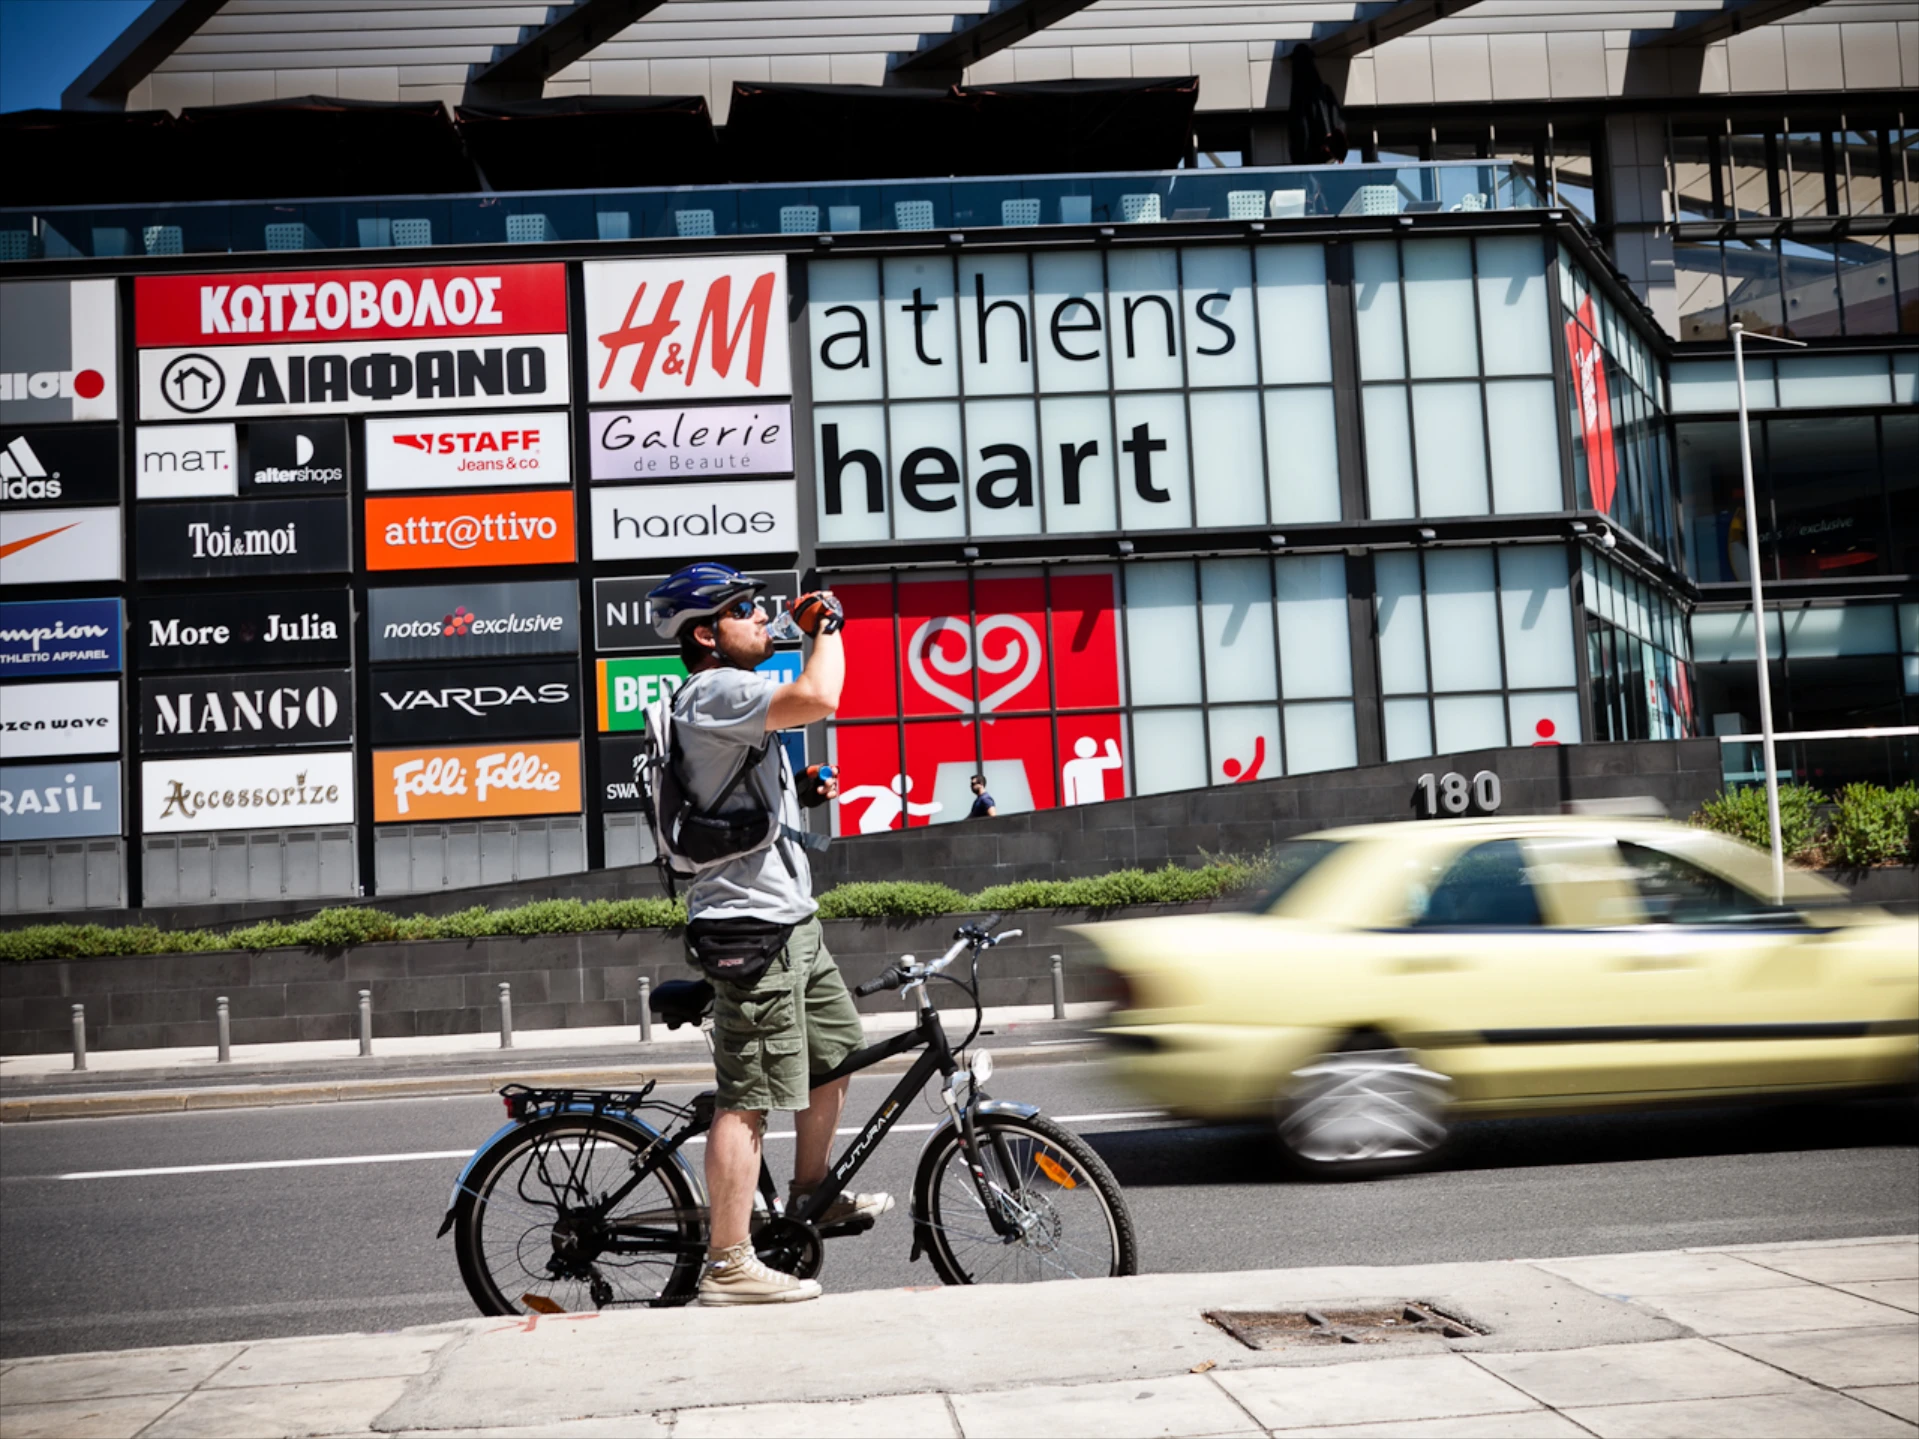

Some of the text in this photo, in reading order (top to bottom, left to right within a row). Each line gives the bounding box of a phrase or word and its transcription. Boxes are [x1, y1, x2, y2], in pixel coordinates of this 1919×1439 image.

[200, 277, 502, 334] ΚΩΤΣΟΒΟΛΟΣ
[819, 273, 1237, 370] athens
[598, 272, 776, 392] H&M
[236, 345, 546, 406] ΔΙΑΦΑΝΟ
[438, 430, 540, 454] STAFF
[601, 412, 780, 451] Galerie
[255, 466, 342, 485] altershops
[634, 453, 750, 472] de Beauté
[819, 421, 1171, 515] heart
[0, 476, 62, 500] idas
[188, 522, 297, 557] Toi&moi
[385, 511, 557, 549] attr@ttivo
[614, 504, 776, 540] haralas
[1799, 516, 1854, 536] exclusive
[149, 613, 337, 647] More Julia
[384, 614, 563, 639] notos exclusive
[53, 649, 110, 661] APPAREL
[156, 686, 338, 735] MANGO
[380, 683, 570, 716] VARDAS
[51, 717, 109, 729] wave
[160, 770, 339, 819] Accessorize
[393, 751, 560, 814] Folli Follie
[1418, 770, 1502, 815] 180
[836, 1117, 887, 1180] FUTURA
